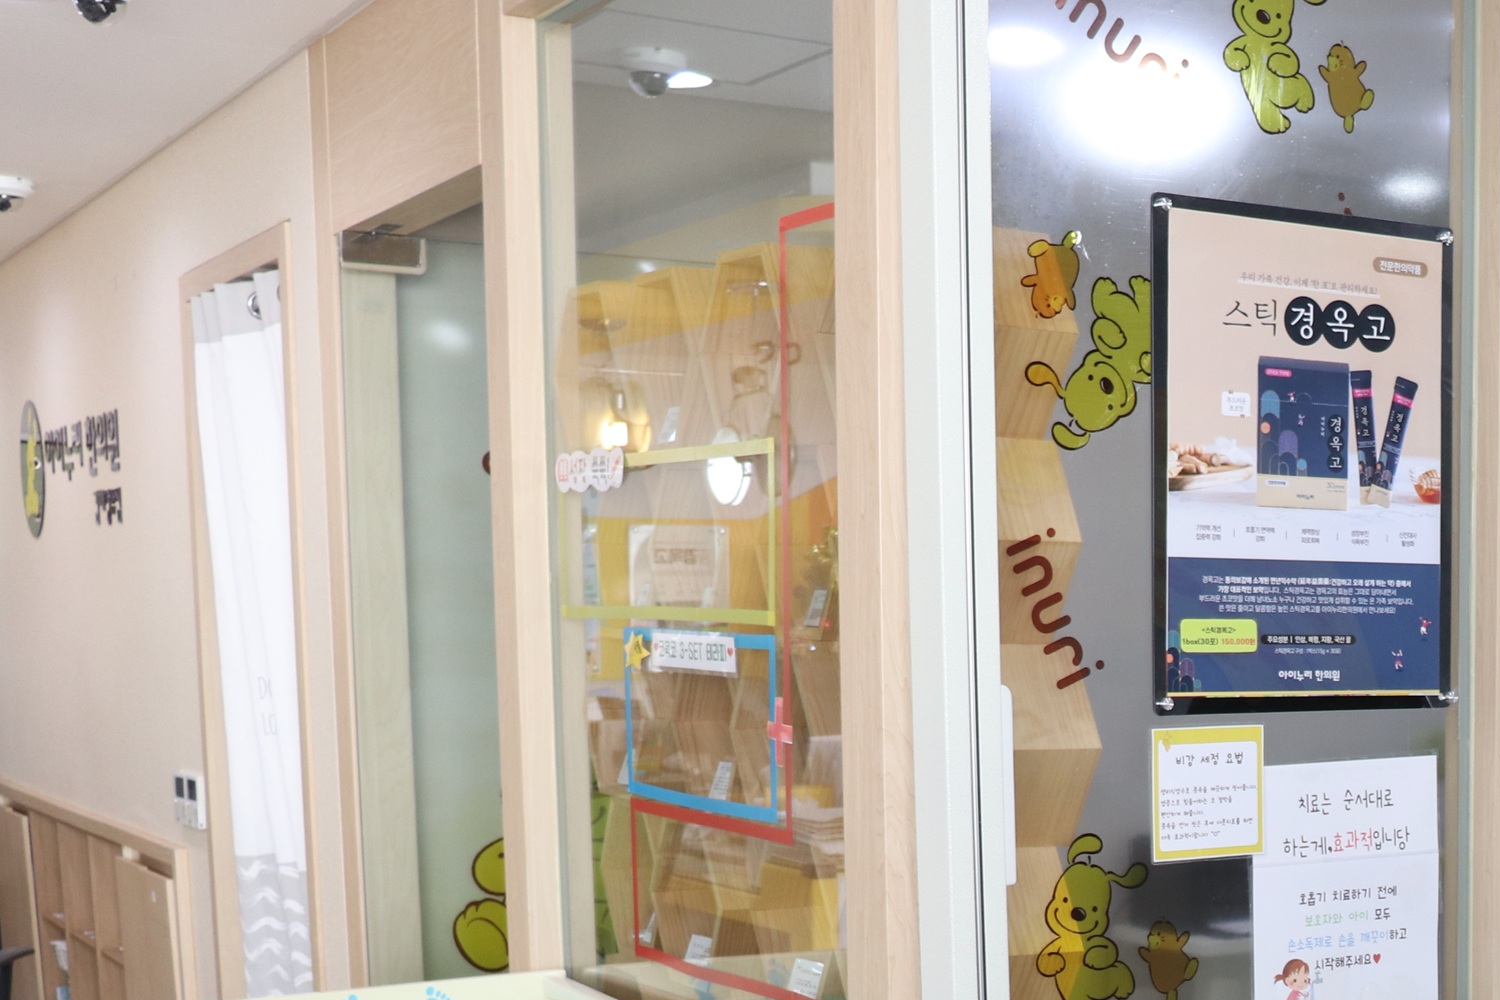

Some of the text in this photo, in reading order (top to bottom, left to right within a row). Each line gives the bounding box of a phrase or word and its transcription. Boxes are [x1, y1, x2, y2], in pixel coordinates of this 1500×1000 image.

[1379, 260, 1421, 276] 전문한의약품
[1240, 271, 1256, 282] 우리
[1257, 273, 1274, 284] 가족
[1275, 275, 1292, 286] 건강,
[1294, 277, 1308, 287] 이제
[1340, 281, 1378, 295] 관리하세요!
[1222, 299, 1391, 343] 스틱 경옥고
[44, 408, 121, 481] 아이누리 한의원
[1329, 416, 1343, 469] 경옥고
[570, 458, 587, 484] 성장
[1202, 575, 1224, 584] 경옥고는
[1218, 585, 1229, 593] 가장
[1230, 586, 1252, 594] 대표적인
[1006, 528, 1105, 690] inuri
[1182, 637, 1256, 646] 1box(30포) 150,000원
[1267, 636, 1288, 644] 주요성분
[680, 641, 703, 660] 3-SET
[706, 643, 727, 662] 테라피
[1278, 670, 1341, 682] 아이누리 한의원
[1175, 752, 1243, 767] 비강 세정 요법
[1299, 789, 1394, 815] 치료는 순서대로
[1332, 887, 1371, 902] 치료하기
[1377, 885, 1397, 900] 전에
[1305, 908, 1391, 927] 보호자와 아이 모두
[1287, 936, 1333, 953] 손소독제로
[1338, 932, 1356, 948] 손을
[1315, 953, 1372, 970] 시작해주세요
